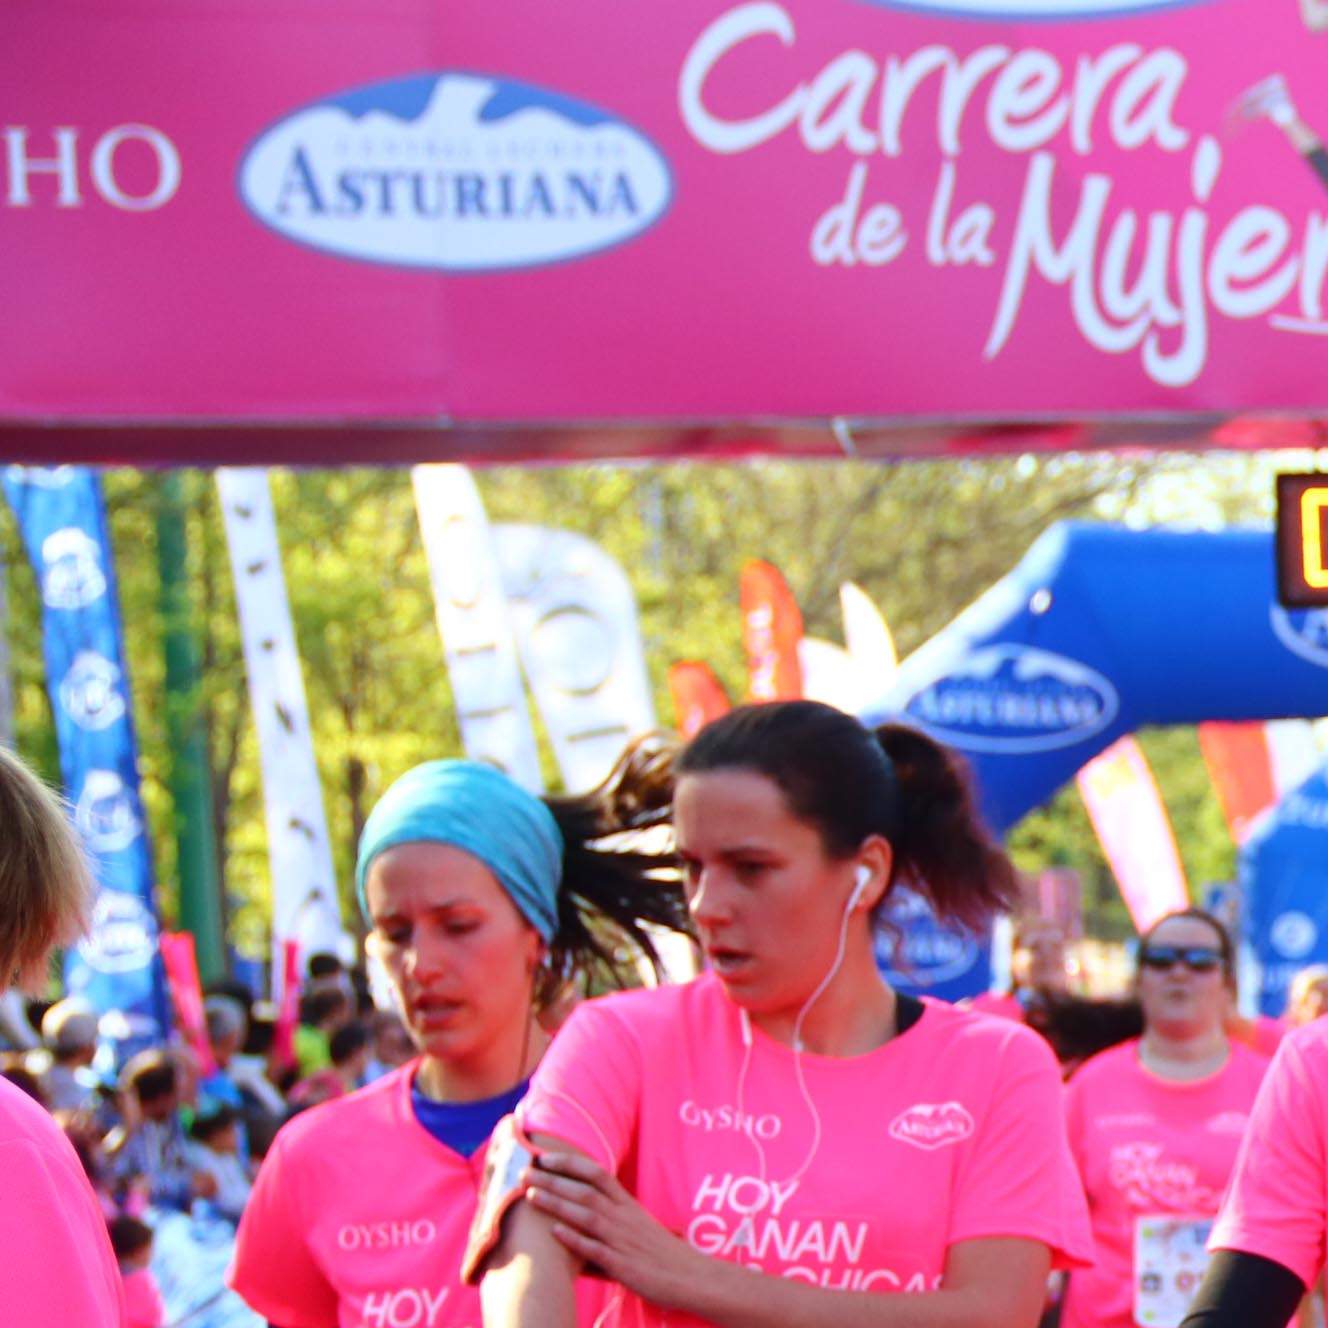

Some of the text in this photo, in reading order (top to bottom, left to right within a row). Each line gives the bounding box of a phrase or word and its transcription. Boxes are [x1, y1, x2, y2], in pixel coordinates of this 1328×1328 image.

[678, 2, 1189, 157] Carrera
[276, 144, 641, 218] ASTURIANA
[809, 160, 908, 266] de
[926, 157, 997, 266] la
[679, 1099, 782, 1140] OYSHO
[691, 1172, 799, 1216] HOY
[338, 1219, 437, 1250] OYSHO
[688, 1213, 869, 1264] GANAN
